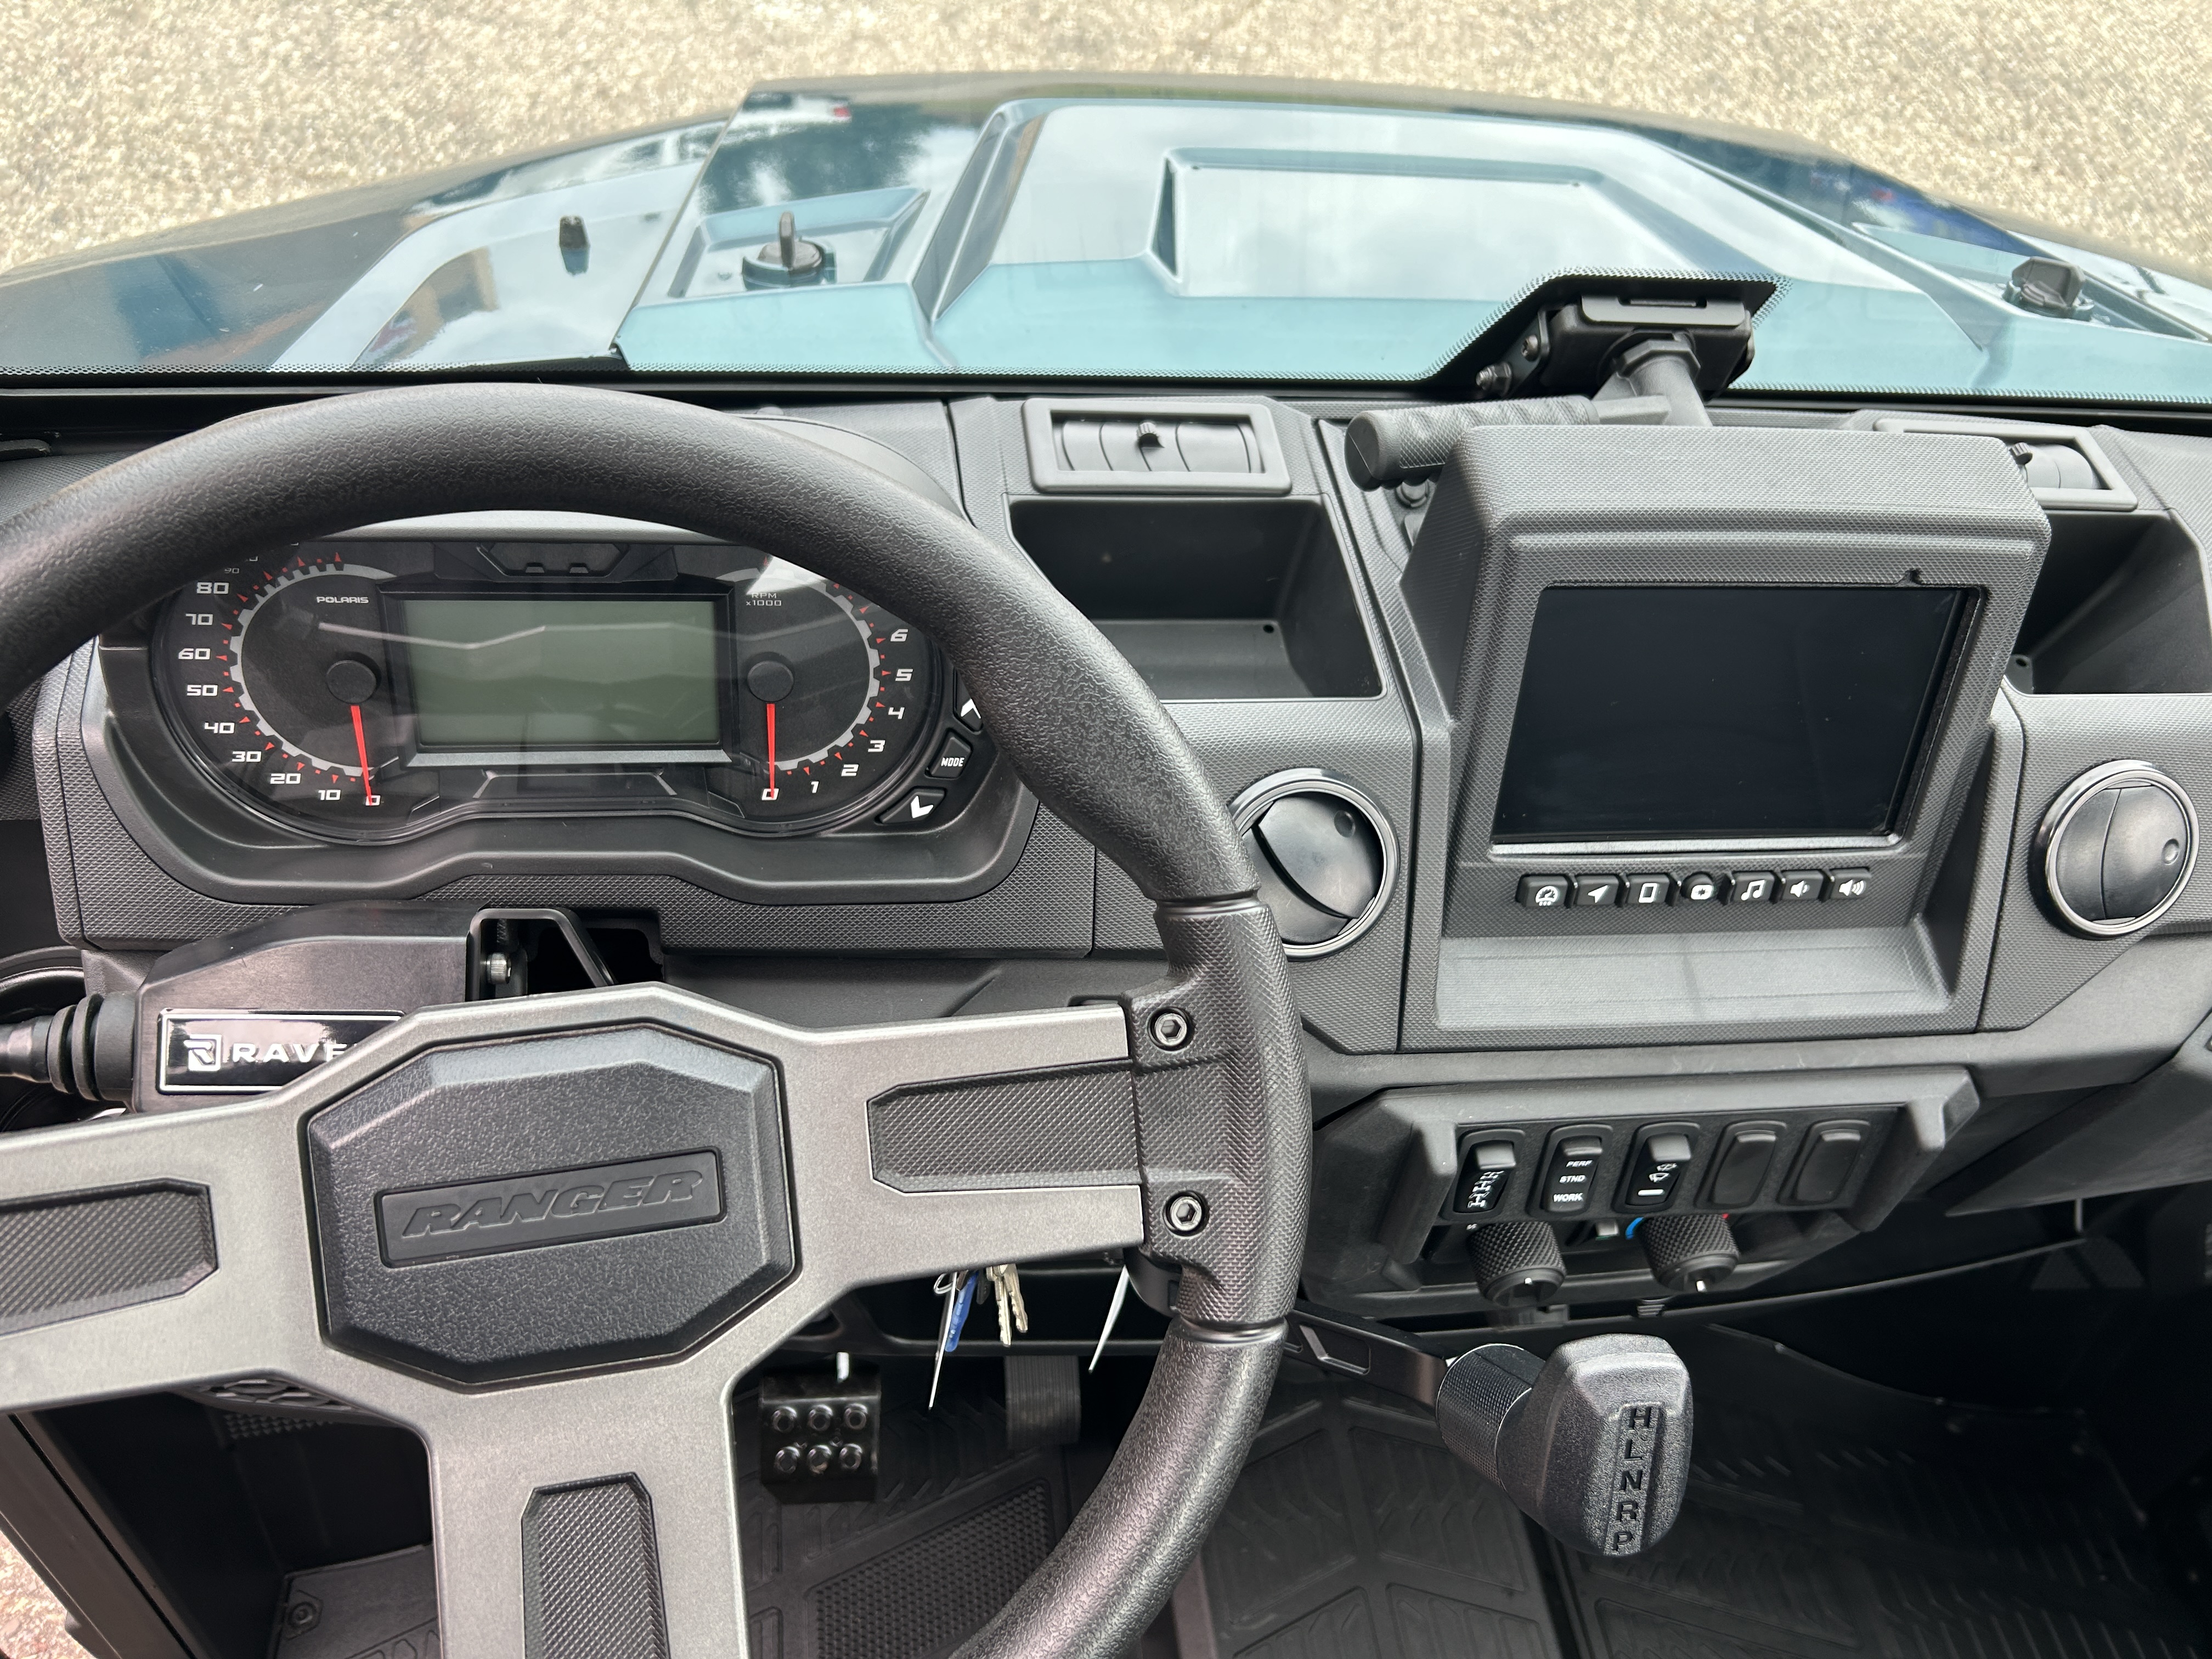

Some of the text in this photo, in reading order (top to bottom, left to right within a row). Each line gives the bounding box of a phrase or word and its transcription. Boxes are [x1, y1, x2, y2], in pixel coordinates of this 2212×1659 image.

[197, 583, 228, 594] 80
[186, 614, 213, 625] 70
[890, 629, 908, 641] 6
[178, 648, 210, 659] 60
[895, 669, 913, 681] 5
[187, 685, 218, 696] 50
[888, 707, 905, 719] 4
[204, 723, 234, 733] 40
[868, 740, 885, 752] 3
[232, 751, 261, 762] 30
[941, 758, 964, 766] MODE
[841, 764, 859, 776] 2
[270, 773, 301, 784] 20
[811, 781, 819, 793] 1
[318, 789, 341, 800] 10
[761, 788, 779, 800] 0
[365, 794, 381, 806] 0
[232, 1042, 357, 1063] RAVE
[1554, 1193, 1583, 1202] WORK
[403, 1170, 703, 1238] RANGER
